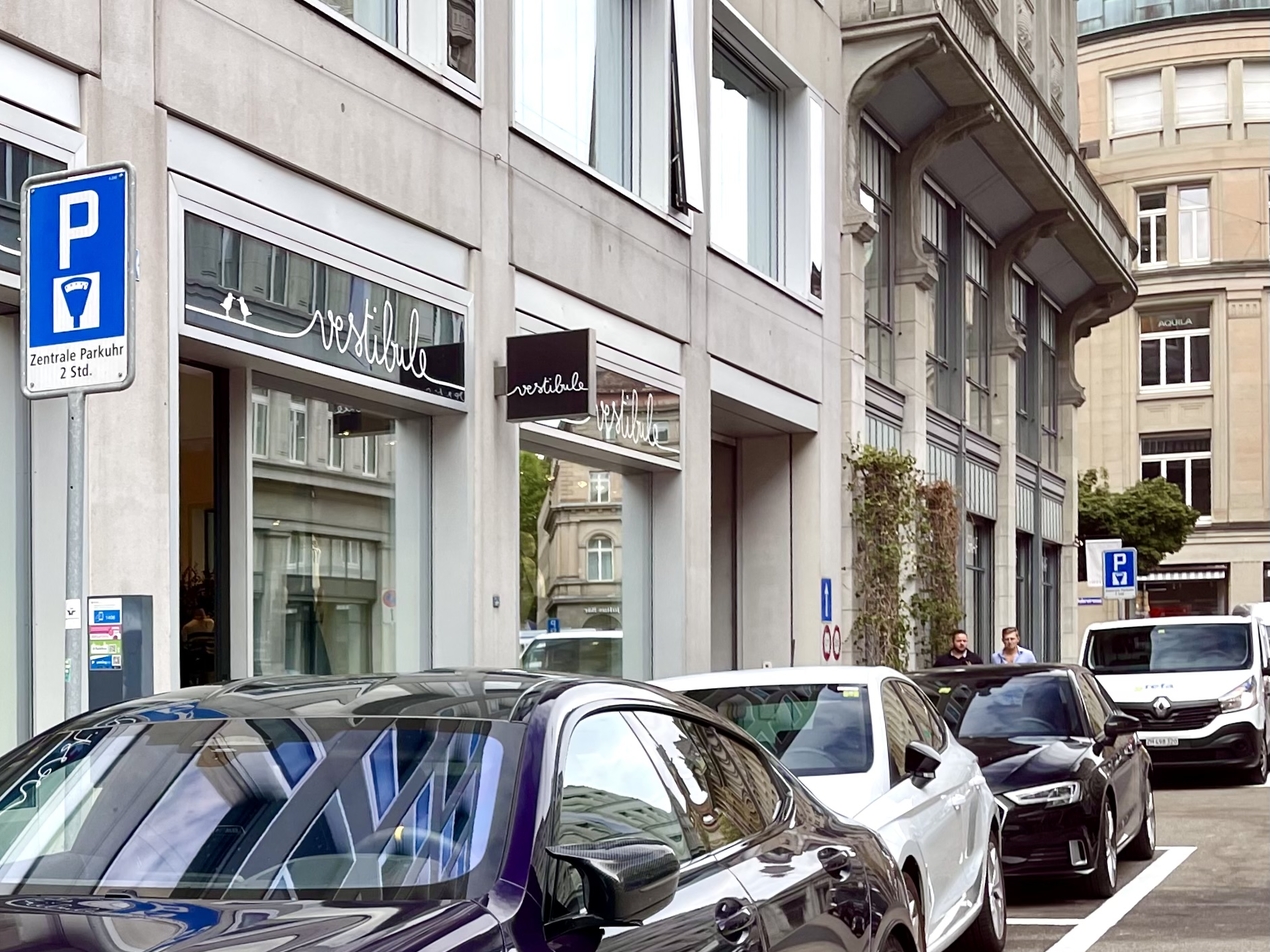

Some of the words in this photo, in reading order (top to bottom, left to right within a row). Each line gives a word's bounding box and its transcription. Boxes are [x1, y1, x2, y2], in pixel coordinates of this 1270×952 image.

[59, 189, 100, 270] P
[1158, 317, 1193, 327] AQUILA
[313, 298, 428, 379] vestibule
[30, 349, 76, 366] Zentrale
[80, 343, 124, 359] Parkuhr
[60, 366, 67, 380] 2
[70, 364, 93, 378] Std.
[510, 371, 586, 397] vestibule
[595, 388, 660, 448] vestibule
[1113, 553, 1127, 572] P
